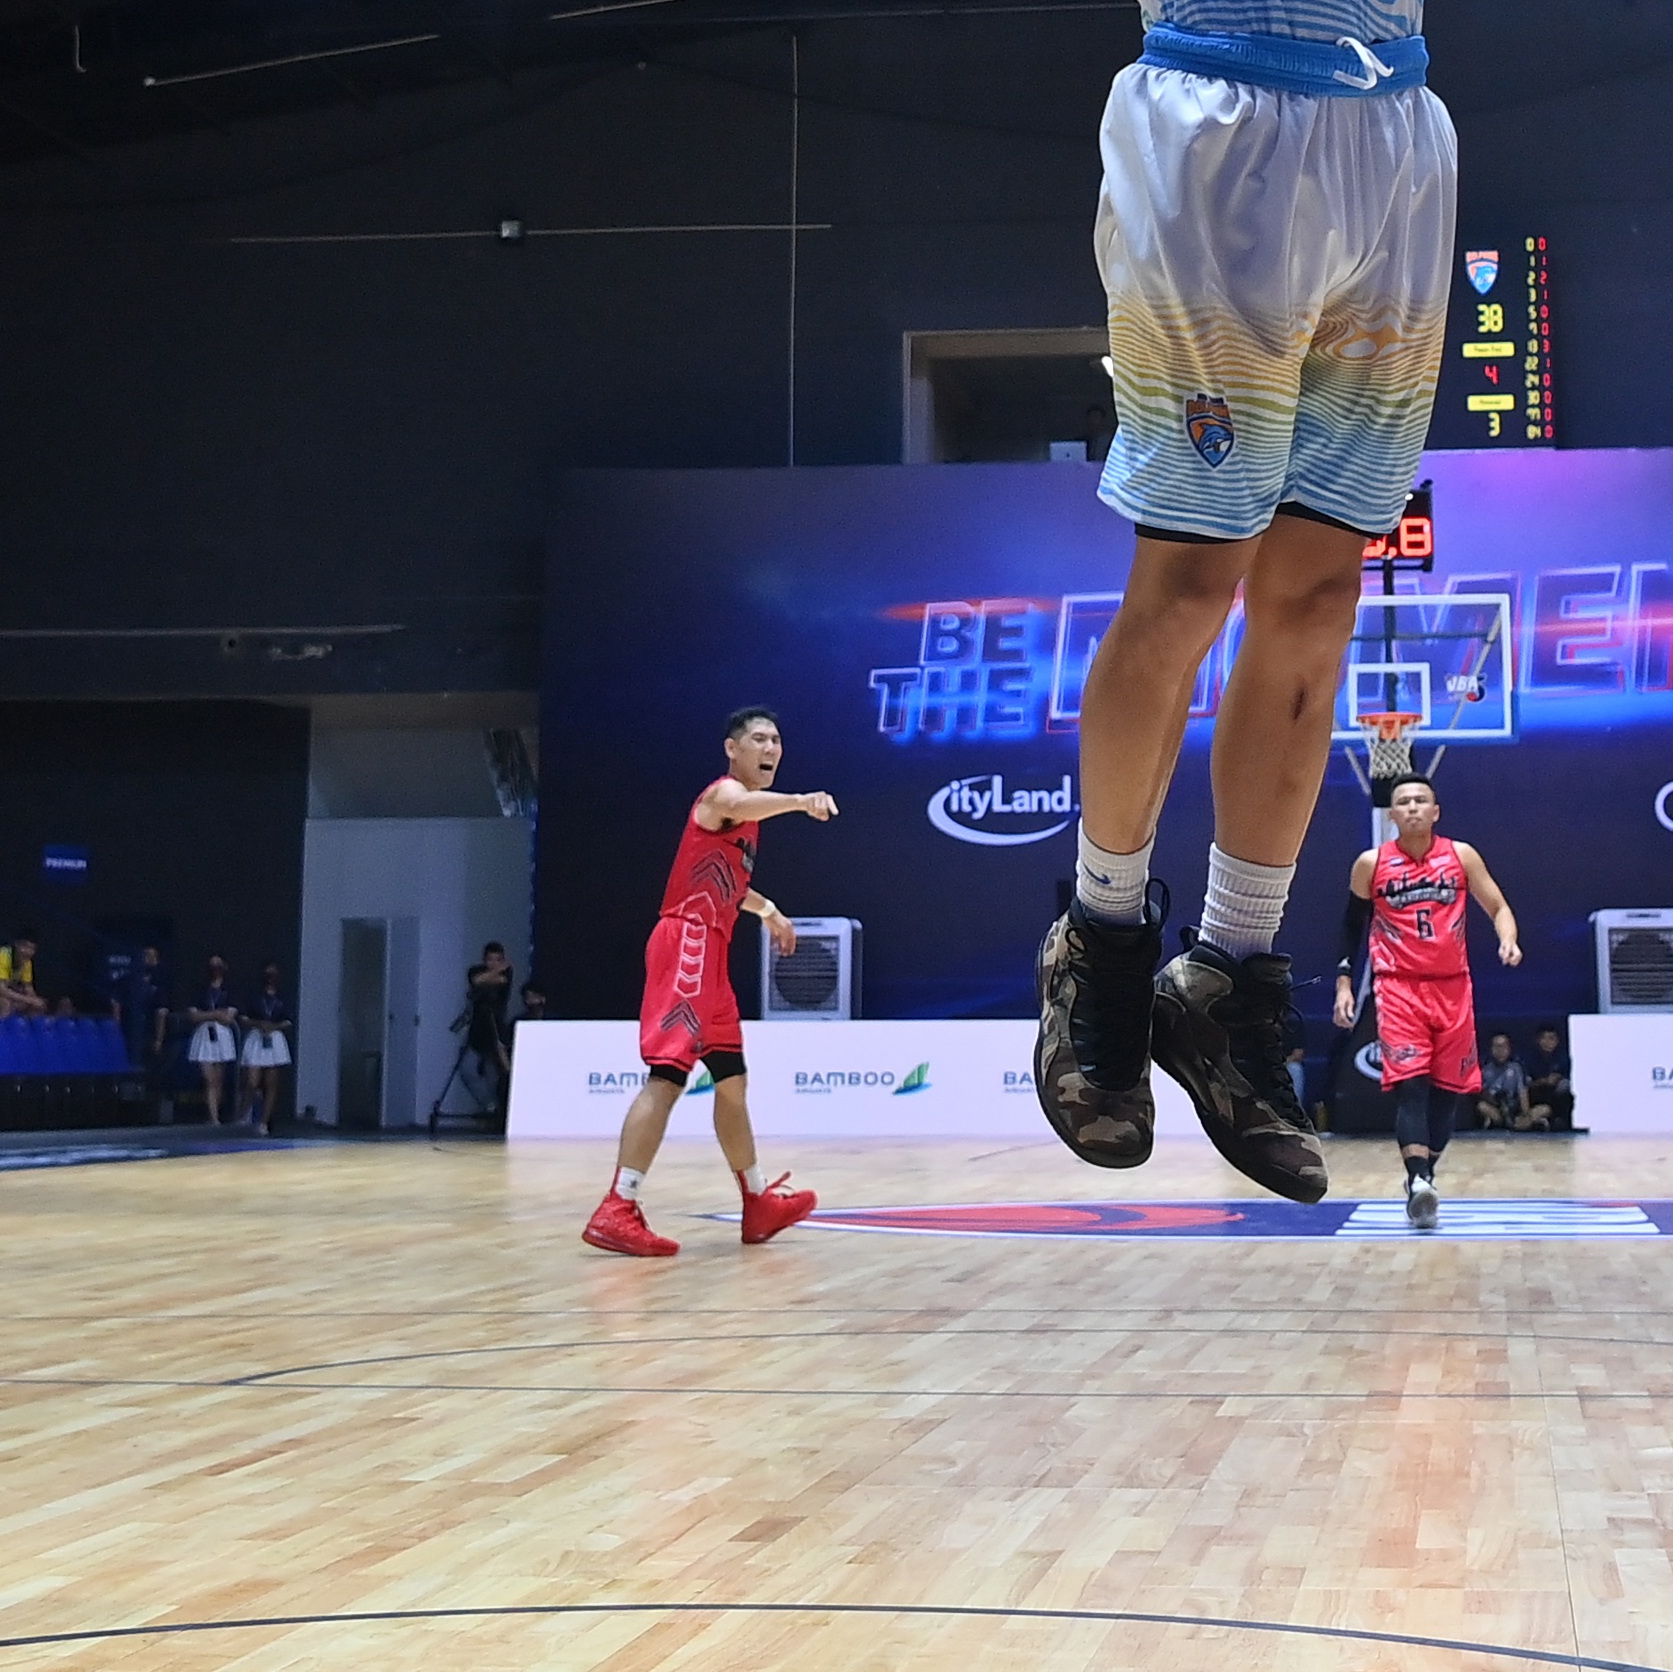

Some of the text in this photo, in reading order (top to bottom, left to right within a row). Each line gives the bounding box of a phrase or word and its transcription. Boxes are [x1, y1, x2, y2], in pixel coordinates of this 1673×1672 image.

[1477, 303, 1503, 333] 38
[1484, 365, 1499, 385] 4
[1488, 412, 1500, 437] 3
[920, 598, 1030, 666] BE
[868, 665, 1032, 738] THE
[927, 775, 1073, 846] CityLand
[588, 1071, 648, 1087] BAM
[794, 1071, 895, 1087] BAMBOO
